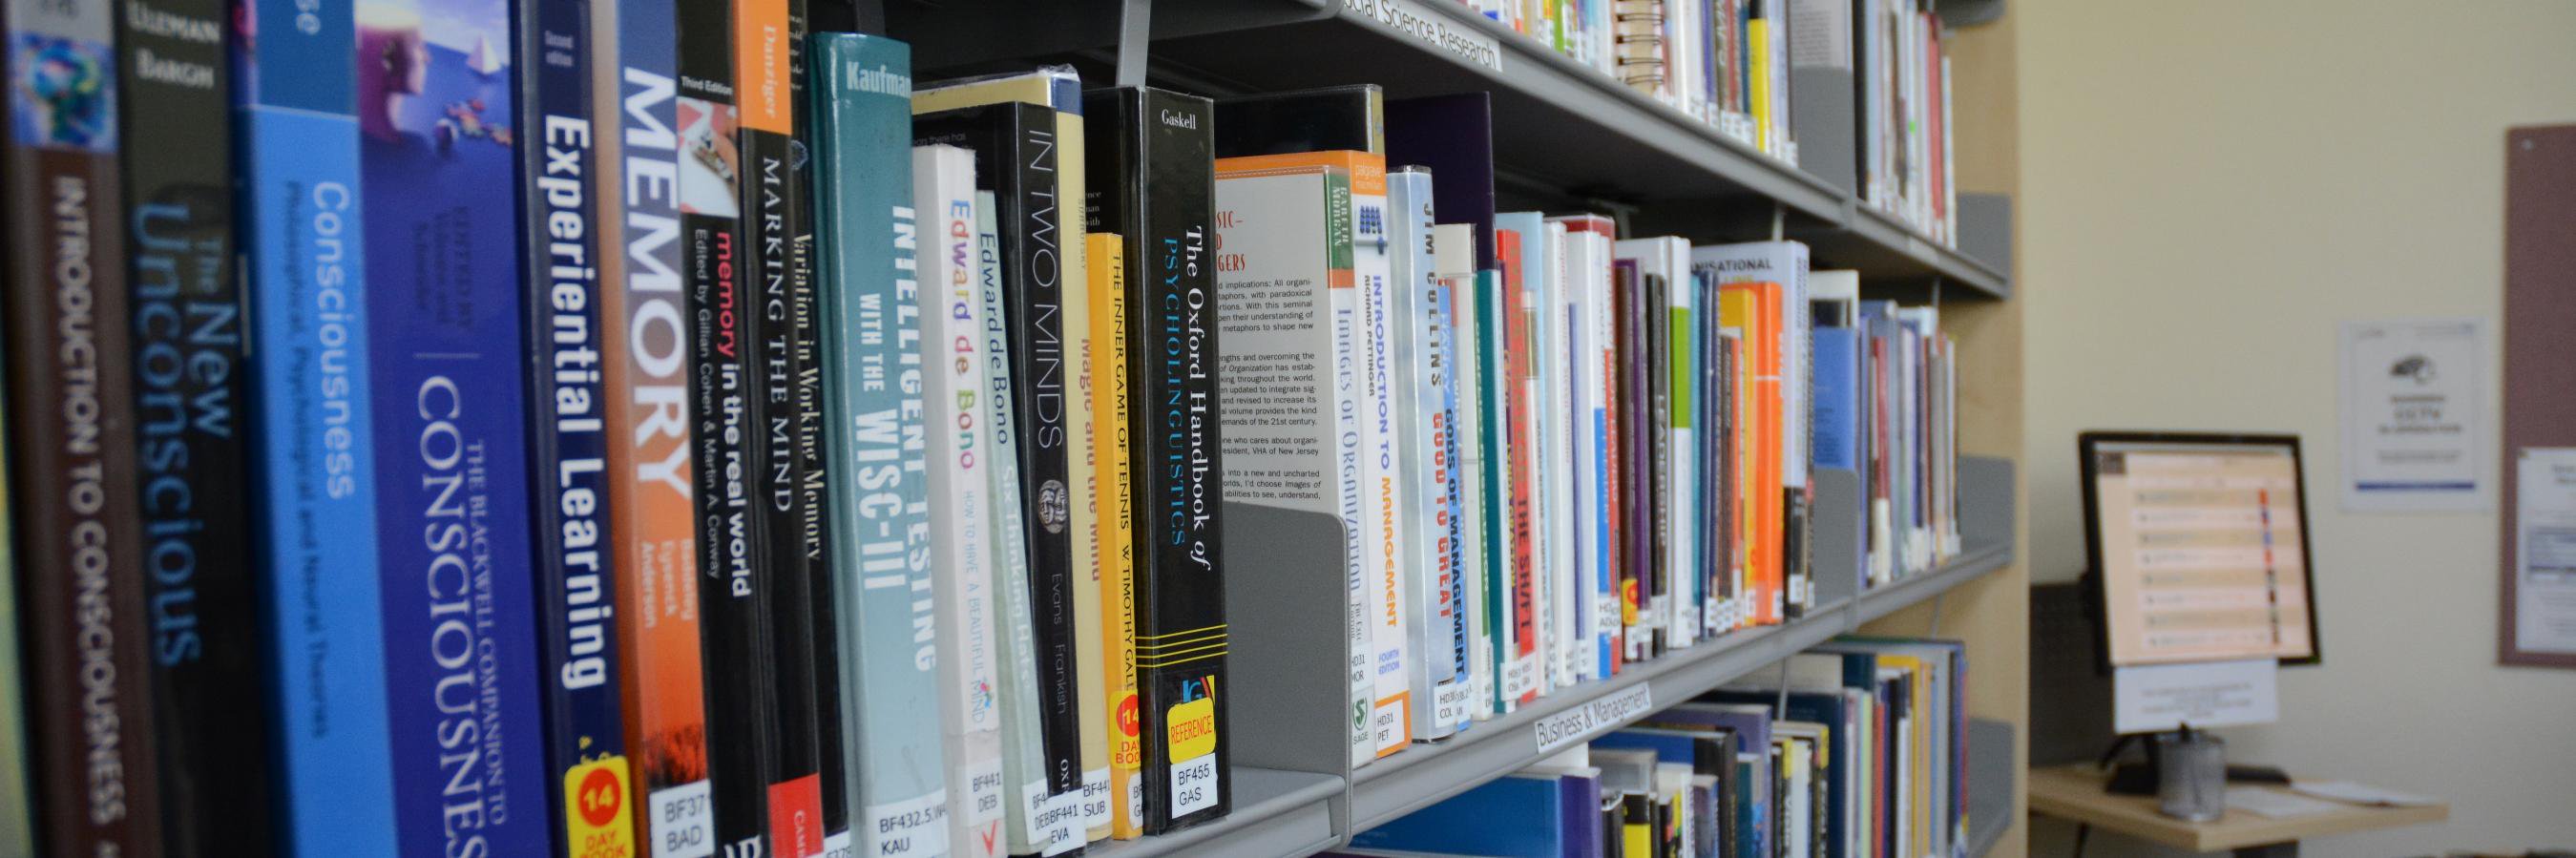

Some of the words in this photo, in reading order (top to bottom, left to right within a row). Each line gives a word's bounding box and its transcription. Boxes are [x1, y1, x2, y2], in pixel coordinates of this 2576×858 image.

[1382, 0, 1435, 44] Science
[1438, 23, 1497, 70] Research
[681, 74, 703, 93] Third
[704, 79, 733, 96] Edition
[1161, 109, 1197, 131] Gaskell
[1029, 128, 1054, 172] IN
[694, 228, 709, 281] Edited
[763, 157, 785, 323] MARKING
[1031, 184, 1057, 288] TWO
[1184, 224, 1204, 279] The
[1424, 202, 1435, 255] JIM
[537, 115, 603, 432] Experiential
[623, 66, 691, 501] MEMORY
[793, 234, 813, 329] Variation
[950, 199, 973, 321] Edward
[980, 233, 1003, 332] Edward
[1113, 251, 1124, 291] THE
[1218, 254, 1246, 272] GERS
[1691, 257, 1773, 274] NISATIONAL
[53, 177, 101, 454] INTRODUCTION
[717, 232, 737, 358] memory
[859, 293, 883, 345] WITH
[1232, 312, 1248, 321] their
[1250, 310, 1304, 321] understanding
[1305, 310, 1314, 319] of
[1246, 302, 1262, 310] With
[1266, 301, 1279, 309] this
[1283, 300, 1313, 308] seminal
[1251, 290, 1267, 299] with
[1269, 288, 1313, 300] paradoxical
[313, 180, 355, 500] Consciousness
[698, 307, 713, 358] Gillian
[797, 337, 813, 360] in
[892, 205, 927, 475] INTELLIGENT
[954, 335, 974, 374] de
[989, 338, 1004, 370] de
[1114, 297, 1124, 359] INNER
[1187, 287, 1206, 380] Oxford
[1223, 324, 1260, 334] metaphors
[1273, 324, 1296, 333] shape
[1373, 275, 1389, 434] INTRODUCTION
[1427, 271, 1441, 387] COLLINS
[187, 302, 239, 440] New
[721, 363, 739, 389] in
[768, 337, 789, 405] THE
[862, 353, 886, 391] THE
[1034, 303, 1063, 449] MINDS
[1228, 364, 1273, 374] Organization
[1237, 375, 1275, 384] throughout
[1258, 353, 1300, 363] overcoming
[1367, 330, 1375, 397] PETTINGER
[700, 361, 714, 415] Cohen
[798, 366, 820, 463] Working
[993, 376, 1009, 446] Bono
[1115, 364, 1126, 422] GAME
[1163, 237, 1186, 547] PSYCHOLINGUISTICS
[1229, 386, 1258, 394] updated
[1269, 386, 1301, 394] integrate
[1255, 408, 1286, 416] provides
[133, 202, 204, 667] Unconscious
[722, 393, 743, 443] the
[956, 389, 975, 470] Bono
[1118, 427, 1127, 453] OF
[1271, 417, 1288, 426] 21st
[1445, 408, 1456, 471] GODS
[467, 440, 484, 491] THE
[702, 437, 716, 491] Martin
[771, 416, 794, 513] MIND
[1189, 388, 1211, 532] Handbook
[1296, 448, 1319, 456] Jersey
[1380, 440, 1391, 471] TO
[1433, 412, 1446, 484] GOOD
[1657, 394, 1667, 547] LEADERSHIP
[69, 464, 104, 515] TO
[726, 450, 747, 509] real
[856, 408, 907, 590] WISC-III
[1002, 465, 1015, 502] Six
[1119, 456, 1130, 531] TENNIS
[1278, 492, 1321, 500] understand,
[1285, 481, 1310, 490] Images
[1448, 478, 1457, 507] OF
[803, 468, 827, 561] Memory
[1518, 498, 1528, 545] THE
[470, 494, 493, 629] BLACKWELL
[705, 513, 722, 579] Conway
[728, 512, 752, 597] world
[1006, 513, 1025, 618] Thinking
[1189, 540, 1211, 571] of
[1381, 476, 1397, 628] MANAGEMENT
[560, 458, 613, 690] Learning
[640, 542, 658, 629] Anderson
[906, 495, 937, 672] TESTING
[1051, 573, 1063, 625] Evans
[1437, 536, 1452, 618] GREAT
[1450, 515, 1465, 676] MANAGEMENT
[1122, 565, 1133, 643] TIMOTHY
[968, 596, 984, 679] BEAUTIFUL
[1016, 624, 1032, 689] Hats
[71, 520, 126, 826] CONSCIOUSNESS
[1055, 644, 1067, 714] Frankish
[1378, 660, 1400, 676] EDITION
[478, 634, 504, 785] COMPANION
[971, 680, 986, 723] MIND
[1377, 713, 1393, 727] HD31
[1537, 714, 1582, 746] Business
[1582, 705, 1592, 729] &
[1593, 686, 1648, 726] Management
[1170, 714, 1213, 745] REFERENCE
[1353, 732, 1369, 745] SAGE
[1377, 729, 1390, 743] PET
[584, 784, 614, 812] 14
[1178, 763, 1210, 786] BF455
[1179, 786, 1203, 806] GAS
[489, 791, 508, 827] TO
[977, 794, 998, 812] DEB
[1050, 805, 1079, 823] BF441
[1084, 801, 1105, 818] SUB
[585, 828, 618, 851] DAY
[666, 826, 702, 851] BAD
[881, 837, 911, 856] KAU
[1051, 827, 1070, 844] EVA
